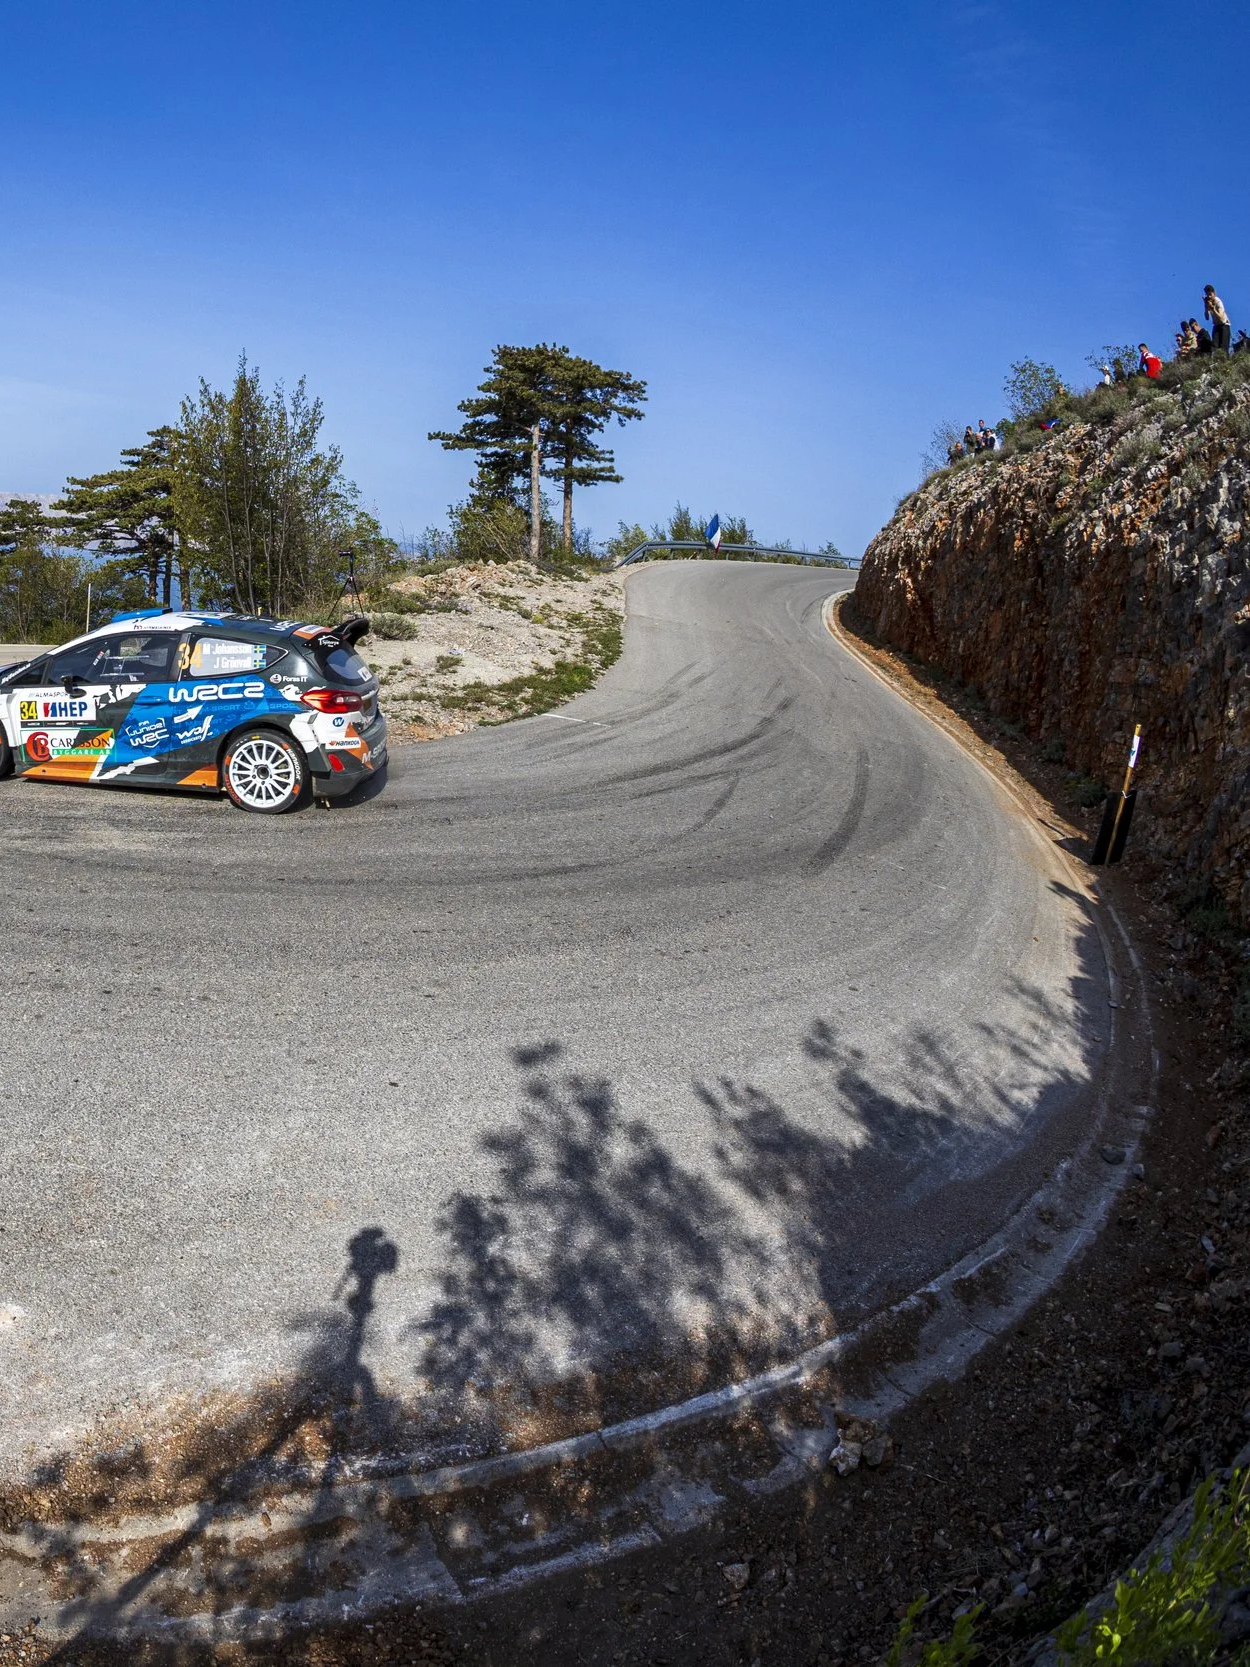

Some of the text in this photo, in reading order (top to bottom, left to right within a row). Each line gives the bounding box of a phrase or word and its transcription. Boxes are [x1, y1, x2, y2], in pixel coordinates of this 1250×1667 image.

[177, 642, 203, 671] 34
[202, 642, 252, 655] M Johansson
[213, 656, 220, 669] J
[168, 682, 265, 703] WRC2
[20, 701, 88, 720] 34 HEP
[50, 737, 111, 748] CARSSON
[130, 728, 170, 747] WRC
